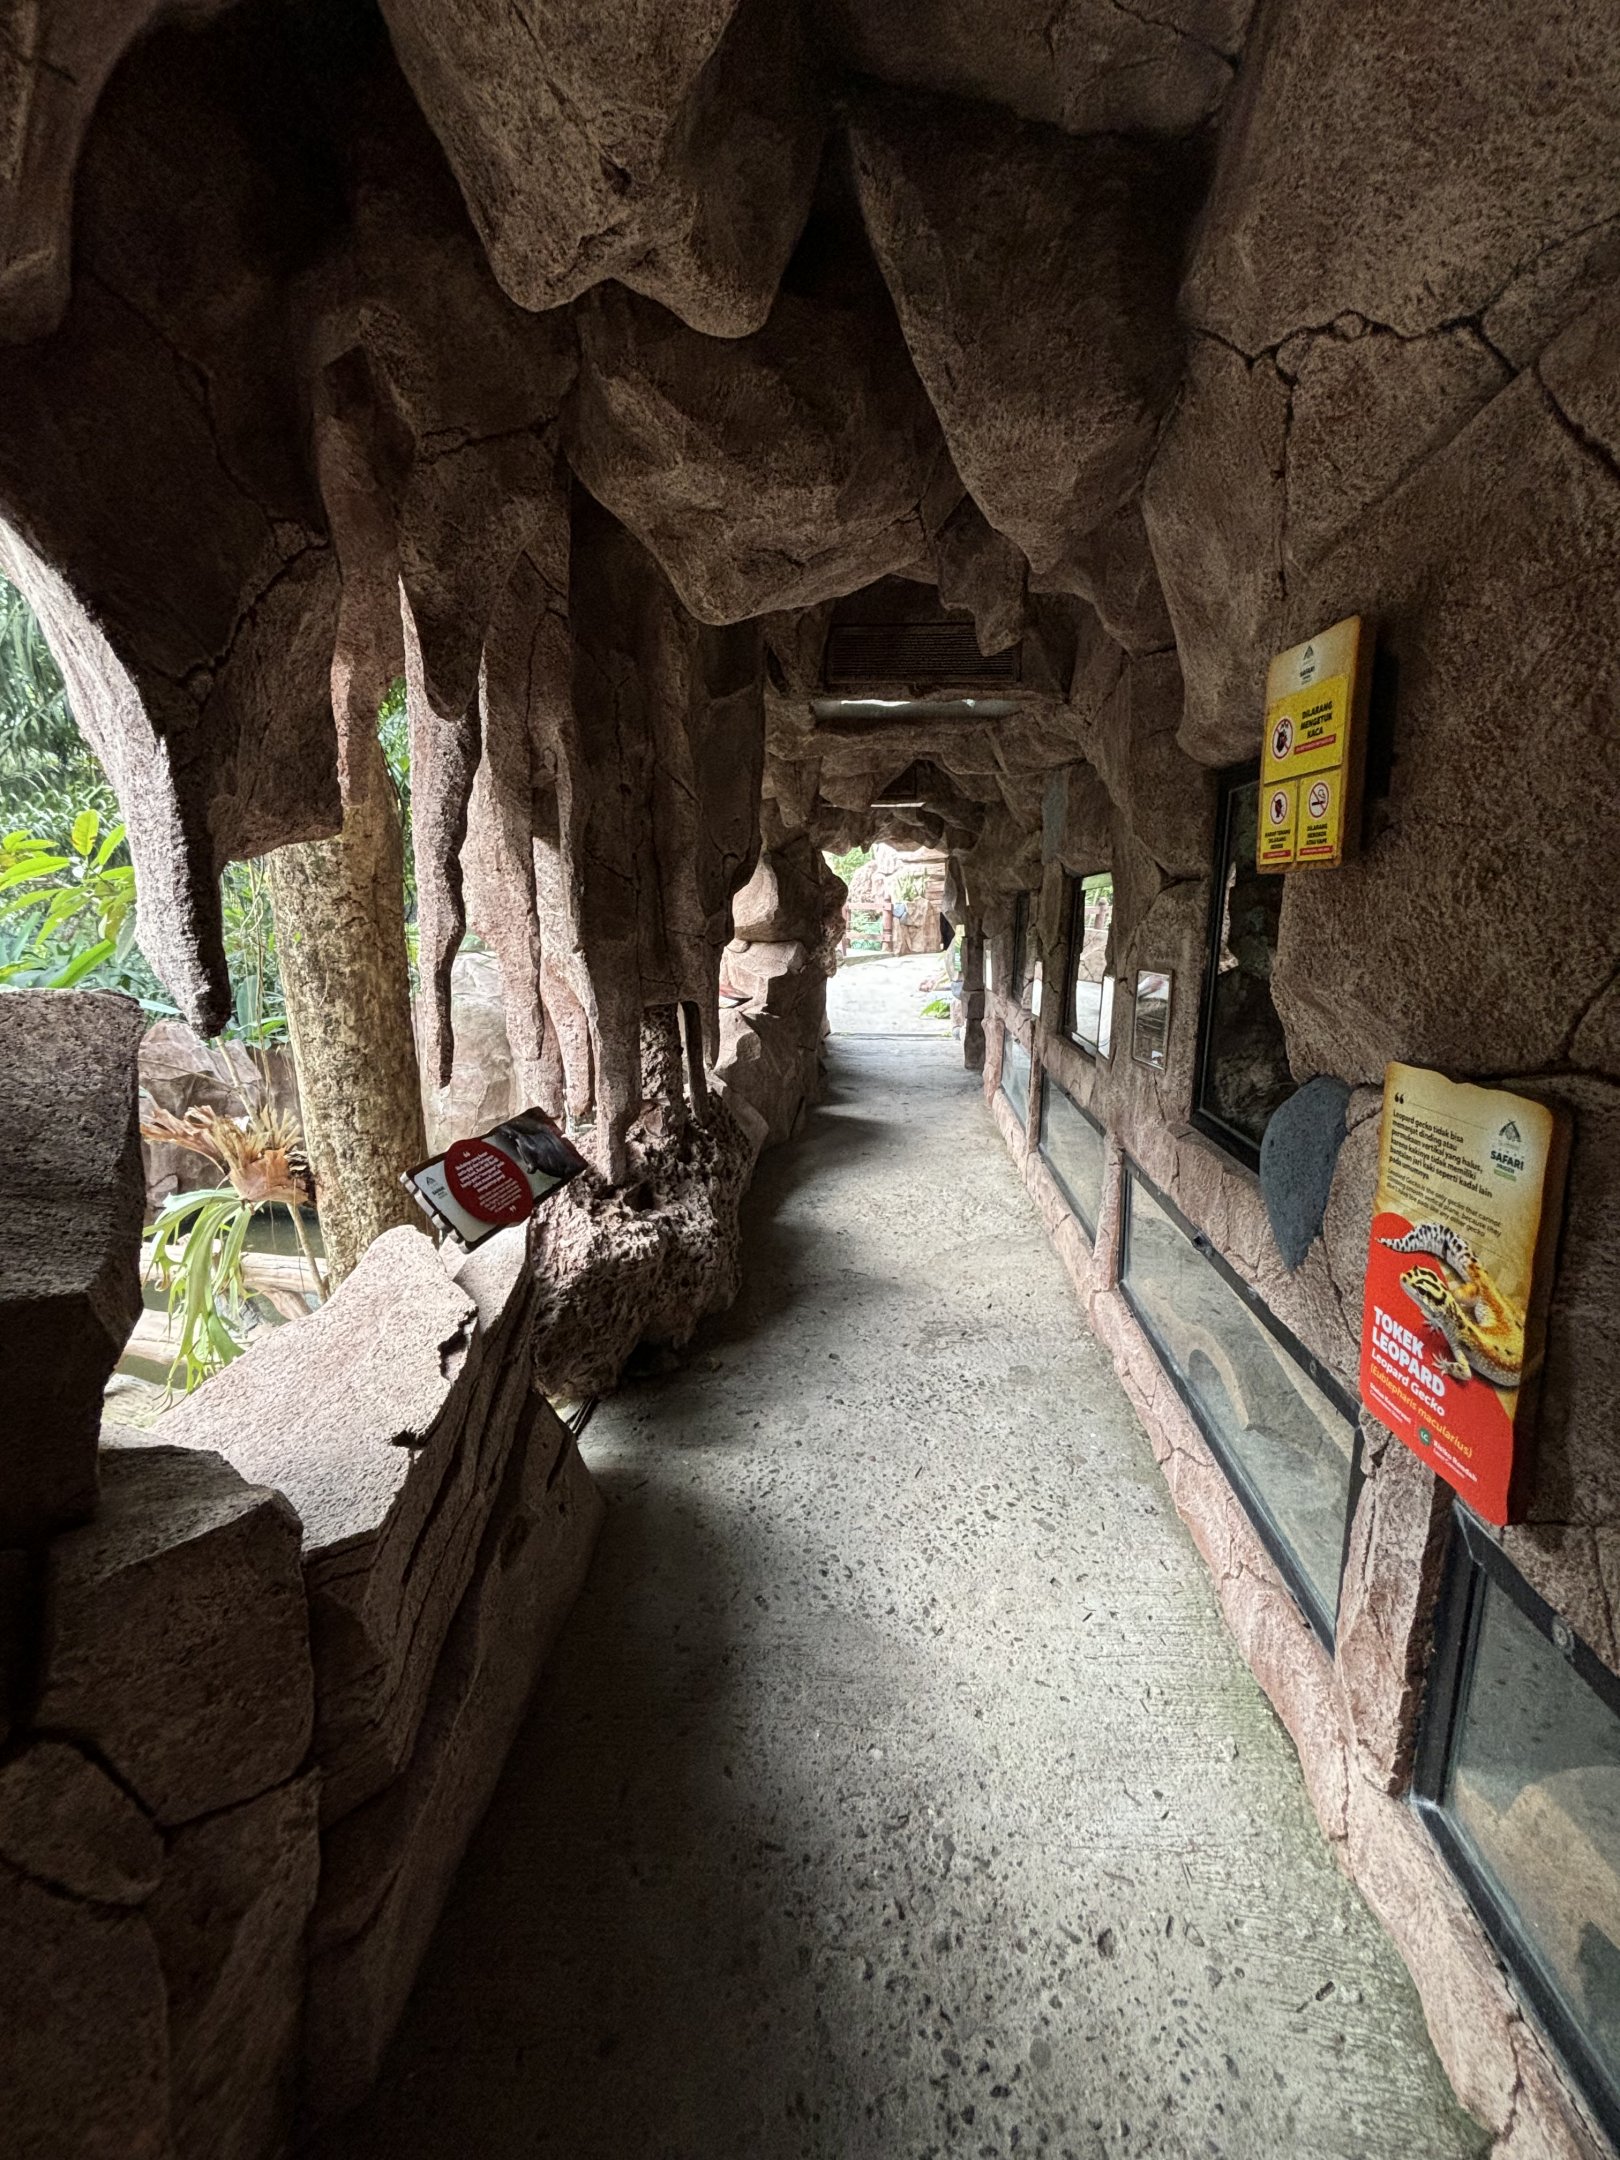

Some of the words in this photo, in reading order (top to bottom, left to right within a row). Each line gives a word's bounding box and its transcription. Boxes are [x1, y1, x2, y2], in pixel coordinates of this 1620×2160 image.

[1302, 700, 1333, 719] DILARANG
[1307, 726, 1323, 739] KACA
[1393, 1122, 1418, 1135] memanjat
[1419, 1131, 1441, 1147] dinding
[1443, 1141, 1457, 1150] atau
[1394, 1111, 1414, 1124] Leopard
[1415, 1120, 1432, 1131] gecko
[1434, 1126, 1449, 1137] tidak
[1450, 1132, 1463, 1143] bisa
[1391, 1139, 1407, 1150] karena
[1409, 1145, 1429, 1160] kakinya
[1431, 1156, 1446, 1167] tidak
[1448, 1164, 1476, 1180] memiliki
[1392, 1131, 1420, 1145] permukaan
[1422, 1143, 1444, 1156] vertikal
[1445, 1153, 1461, 1165] yang
[1462, 1157, 1482, 1173] halus,
[1491, 1151, 1524, 1171] SAFARI
[1389, 1157, 1401, 1165] pada
[1402, 1164, 1429, 1179] umumnya
[1390, 1147, 1412, 1161] bantalan
[1413, 1158, 1422, 1166] jari
[1423, 1161, 1435, 1172] kaki
[1436, 1169, 1458, 1183] seperti
[1459, 1177, 1478, 1191] kadal
[1479, 1186, 1493, 1198] lain
[1462, 1213, 1486, 1229] because
[1487, 1226, 1501, 1239] they
[1466, 1207, 1478, 1217] that
[1373, 1306, 1424, 1360] TOKEK
[1372, 1327, 1446, 1399] LEOPARD
[1372, 1348, 1409, 1387] Leopard
[1411, 1380, 1445, 1417] Gecko
[1371, 1364, 1416, 1410] (Eublepharis
[1419, 1407, 1473, 1458] macularius)
[1434, 1440, 1452, 1459] Risiko
